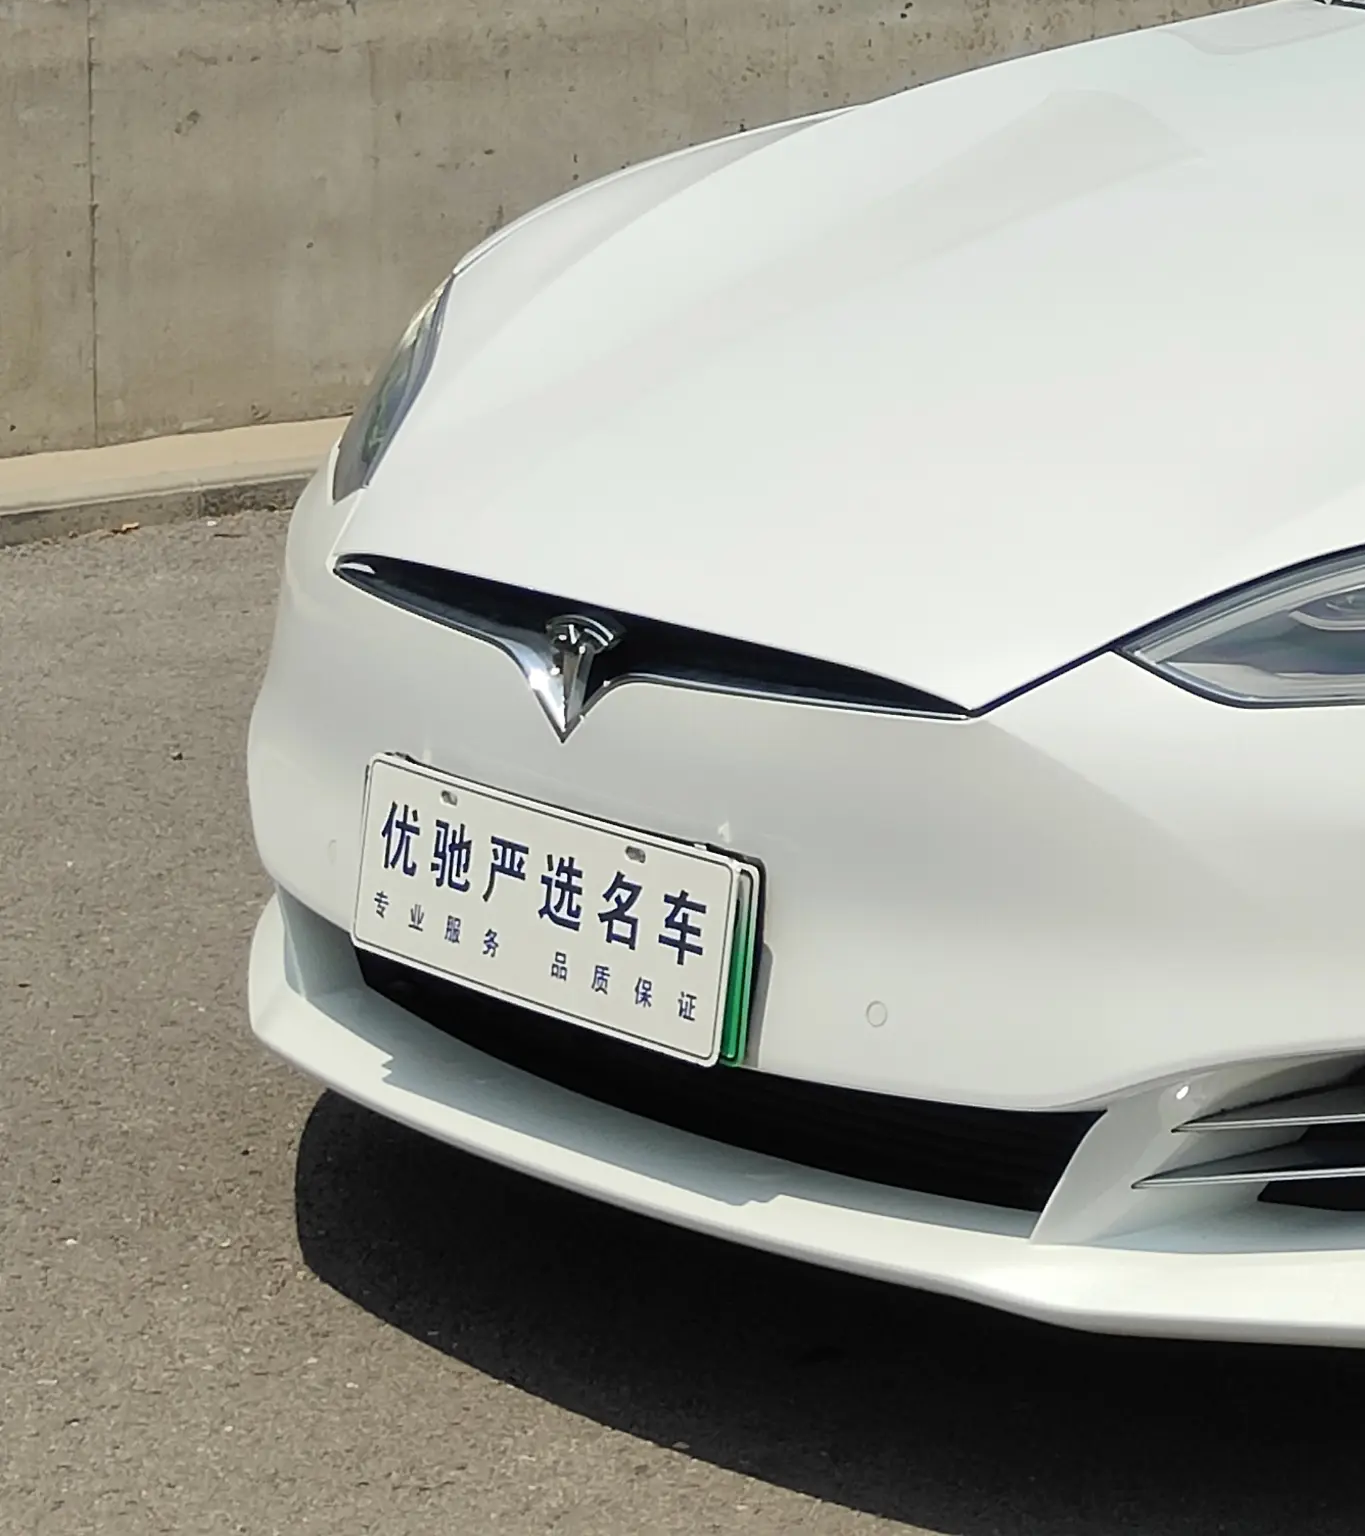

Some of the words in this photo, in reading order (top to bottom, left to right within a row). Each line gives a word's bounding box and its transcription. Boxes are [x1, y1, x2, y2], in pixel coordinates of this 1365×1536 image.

[373, 890, 501, 959] 专业服务
[550, 951, 697, 1023] 品质保证
[381, 801, 708, 966] 优驰严选名车
